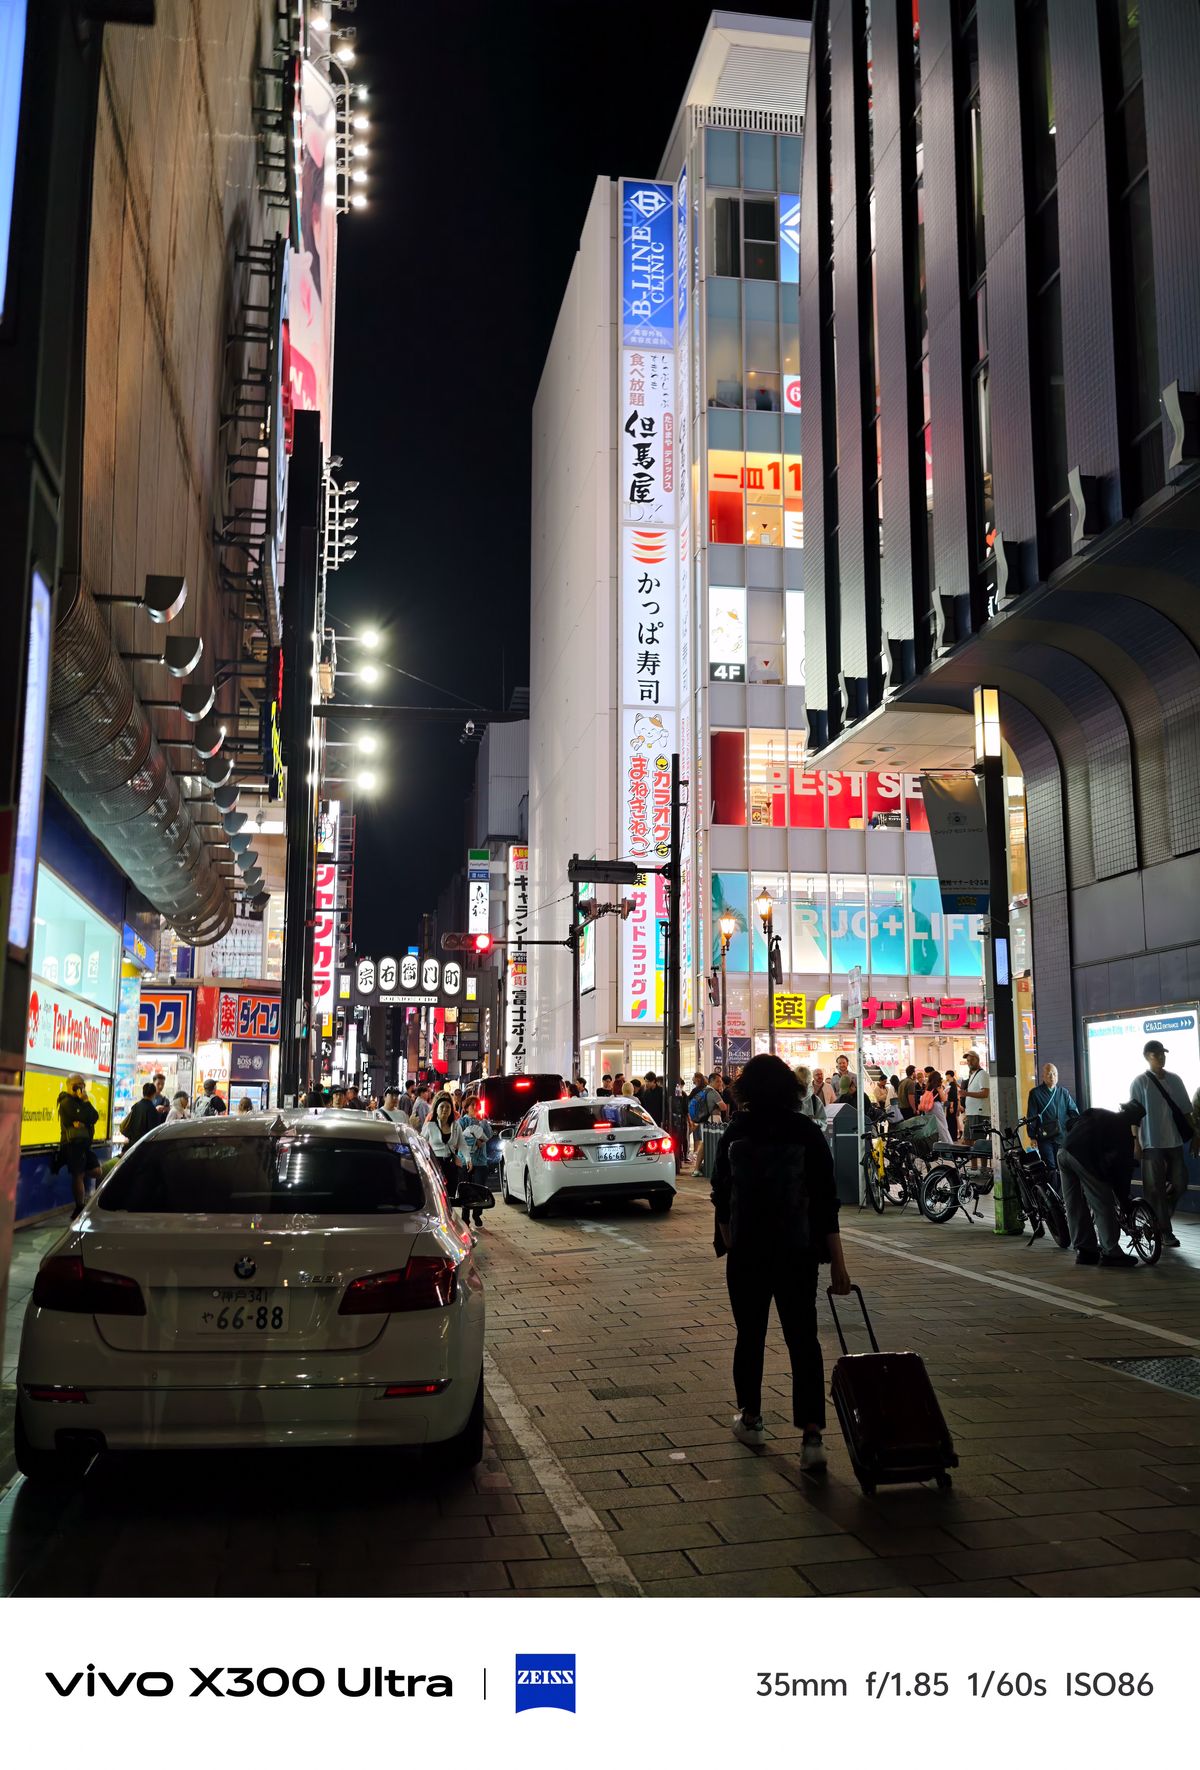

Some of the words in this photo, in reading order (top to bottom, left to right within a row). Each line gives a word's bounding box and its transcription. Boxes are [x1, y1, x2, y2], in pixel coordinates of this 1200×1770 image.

[632, 226, 651, 316] B-LINE
[651, 241, 665, 303] CLINIC
[629, 353, 645, 407] 食べ放題
[624, 409, 657, 504] 但馬屋
[636, 572, 664, 705] かっぱ寿司
[714, 665, 741, 680] 4F
[766, 767, 867, 797] BEST
[653, 771, 671, 842] カラオケ
[631, 891, 647, 995] サンドラッグ
[359, 963, 459, 988] 宗右衛門町
[53, 1003, 67, 1051] Tax
[66, 1009, 83, 1057] Free
[83, 1016, 99, 1064] Shop
[221, 995, 236, 1036] 薬
[240, 1000, 280, 1035] ダイコク
[775, 996, 803, 1025] 薬
[603, 1152, 625, 1161] 66-66
[217, 1305, 284, 1330] 66-88
